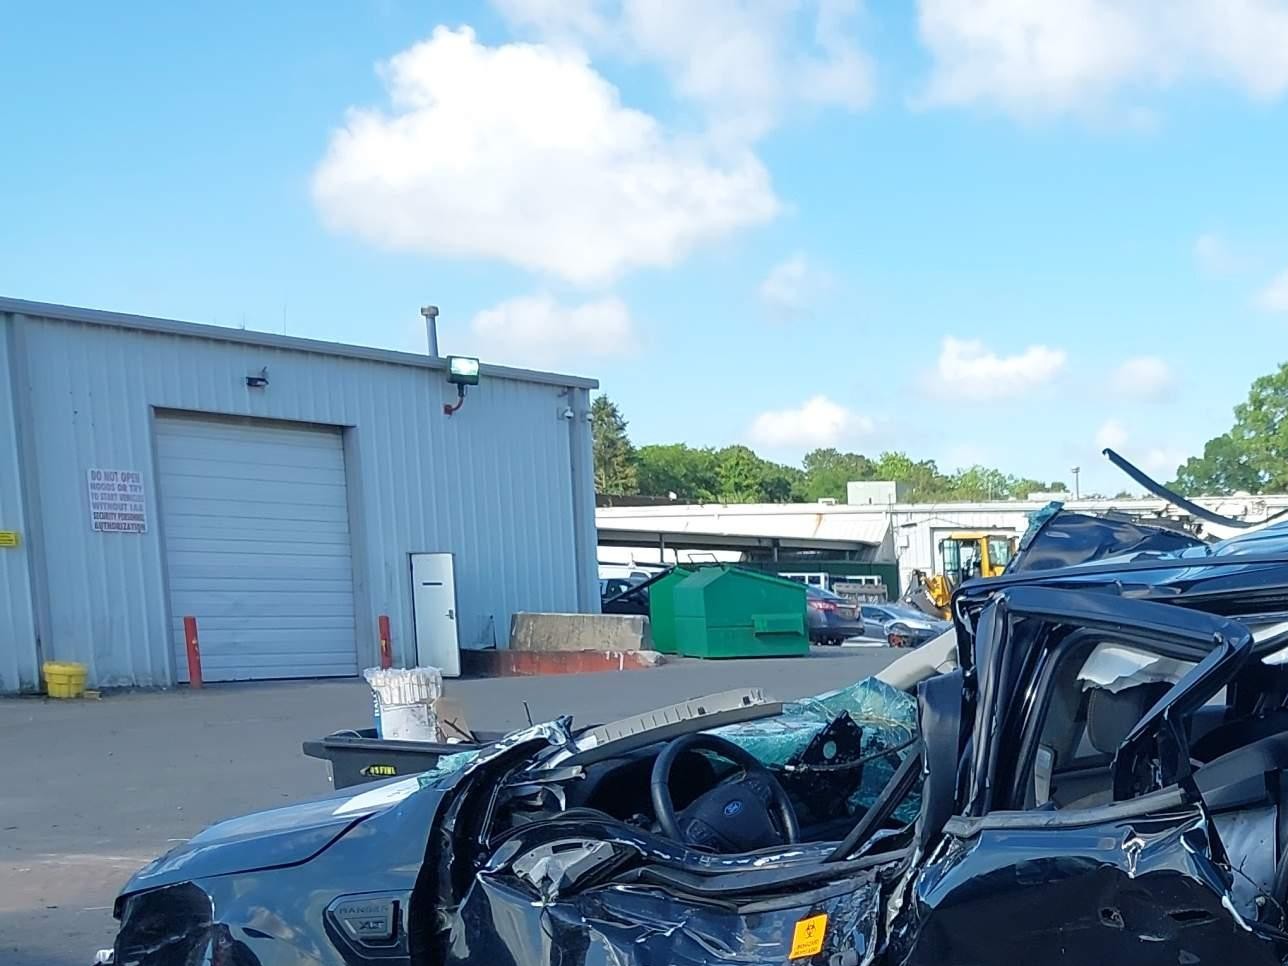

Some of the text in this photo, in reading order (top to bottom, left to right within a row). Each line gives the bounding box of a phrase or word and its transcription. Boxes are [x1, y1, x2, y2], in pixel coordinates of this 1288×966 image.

[91, 470, 141, 483] DO NOT OPEN
